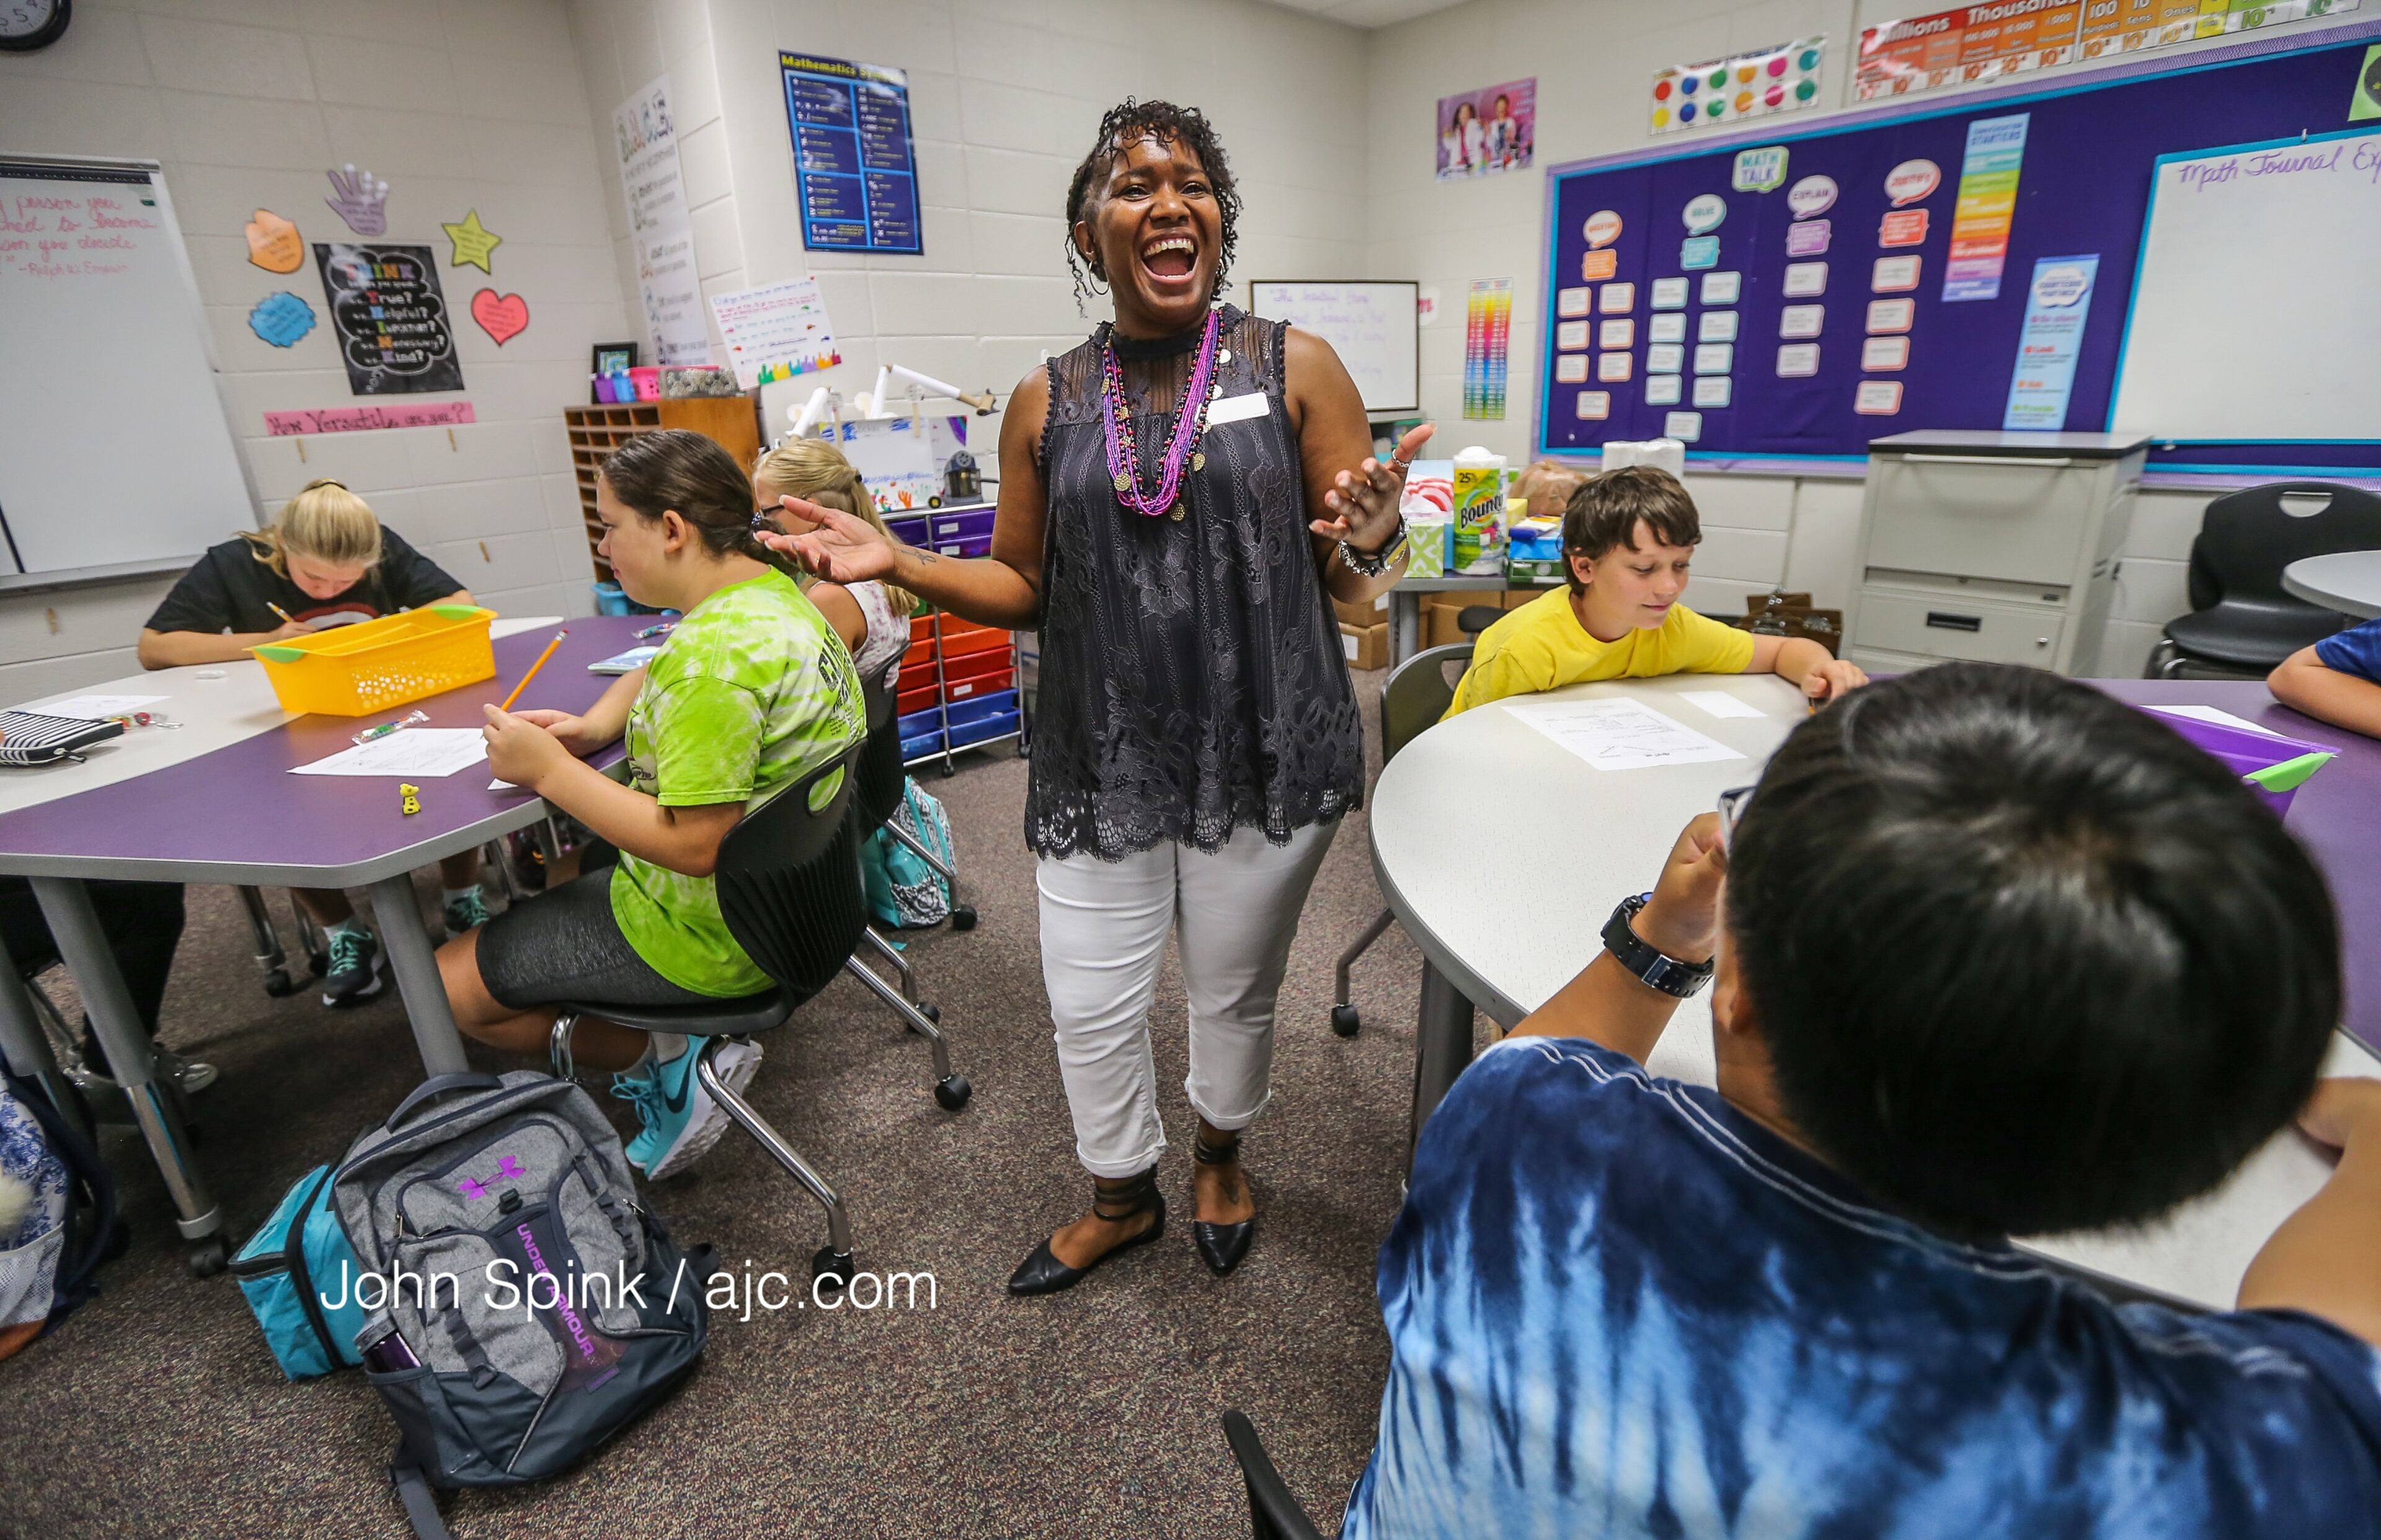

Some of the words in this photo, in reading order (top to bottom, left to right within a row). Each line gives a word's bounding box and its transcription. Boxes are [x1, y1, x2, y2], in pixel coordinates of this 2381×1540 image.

[2089, 1, 2118, 20] 100
[2127, 14, 2153, 25] Tens
[2163, 6, 2196, 17] Ones
[781, 54, 856, 76] Mathematics
[1742, 151, 1780, 167] MATH
[1742, 167, 1775, 184] TALK
[2178, 159, 2239, 192] Math
[2245, 145, 2344, 176] Journal
[366, 290, 413, 304] True?
[1461, 494, 1504, 529] Bounty
[517, 1223, 552, 1282] UNDER
